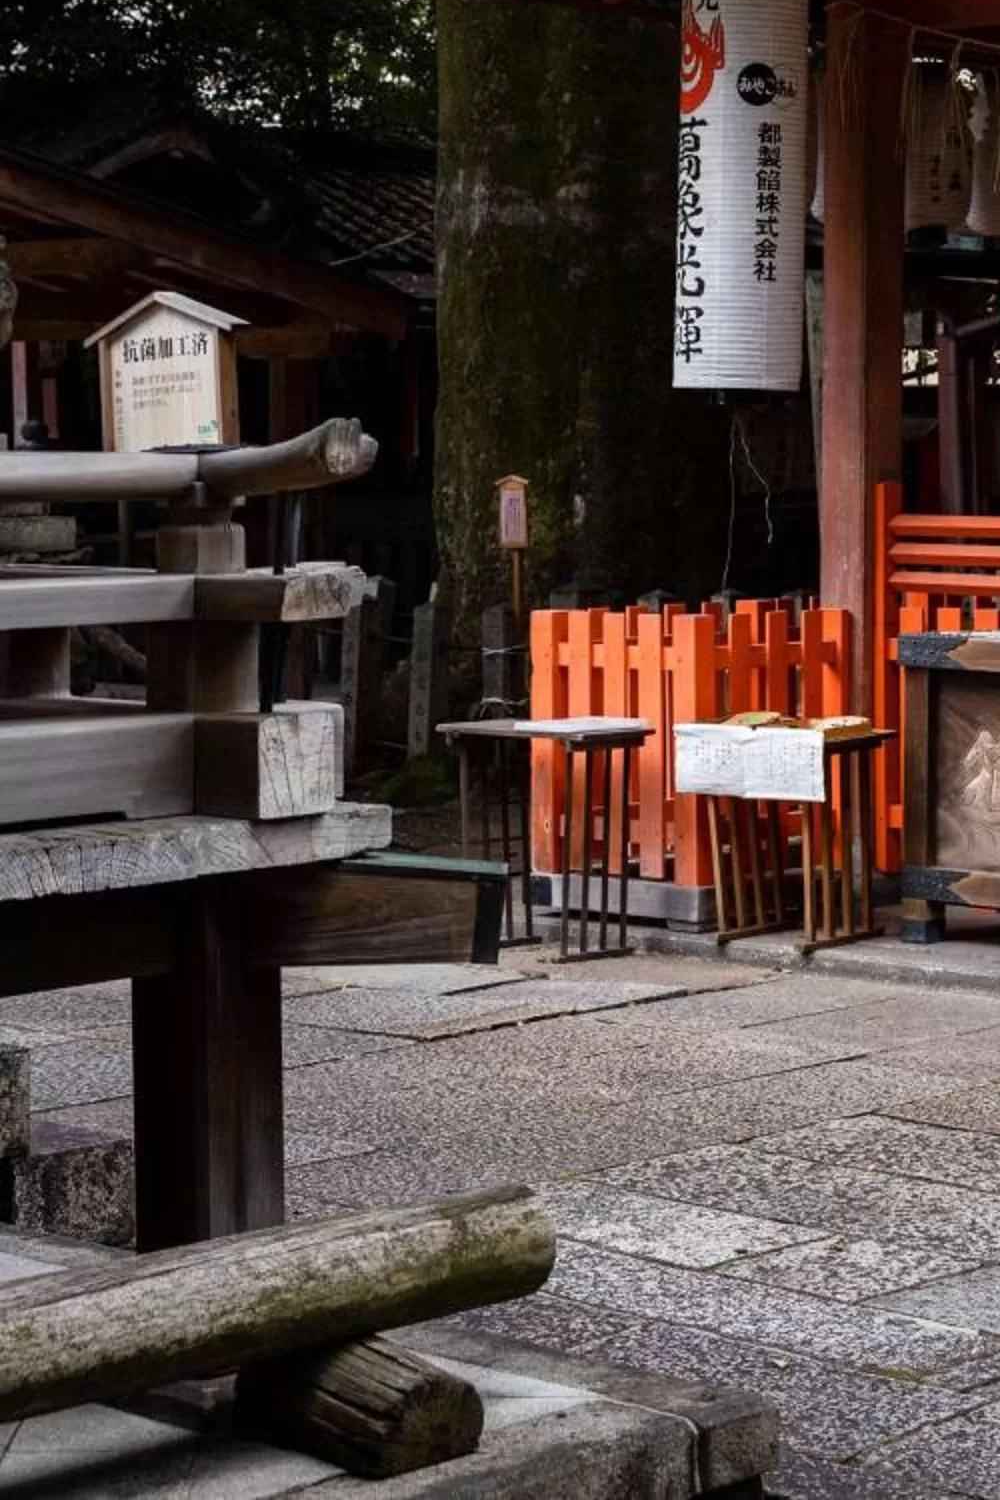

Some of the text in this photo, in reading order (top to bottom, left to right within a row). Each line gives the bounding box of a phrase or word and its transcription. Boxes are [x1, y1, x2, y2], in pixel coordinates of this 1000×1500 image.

[753, 122, 783, 283] 都製餡株式会社
[123, 332, 208, 364] 抗菌加工済
